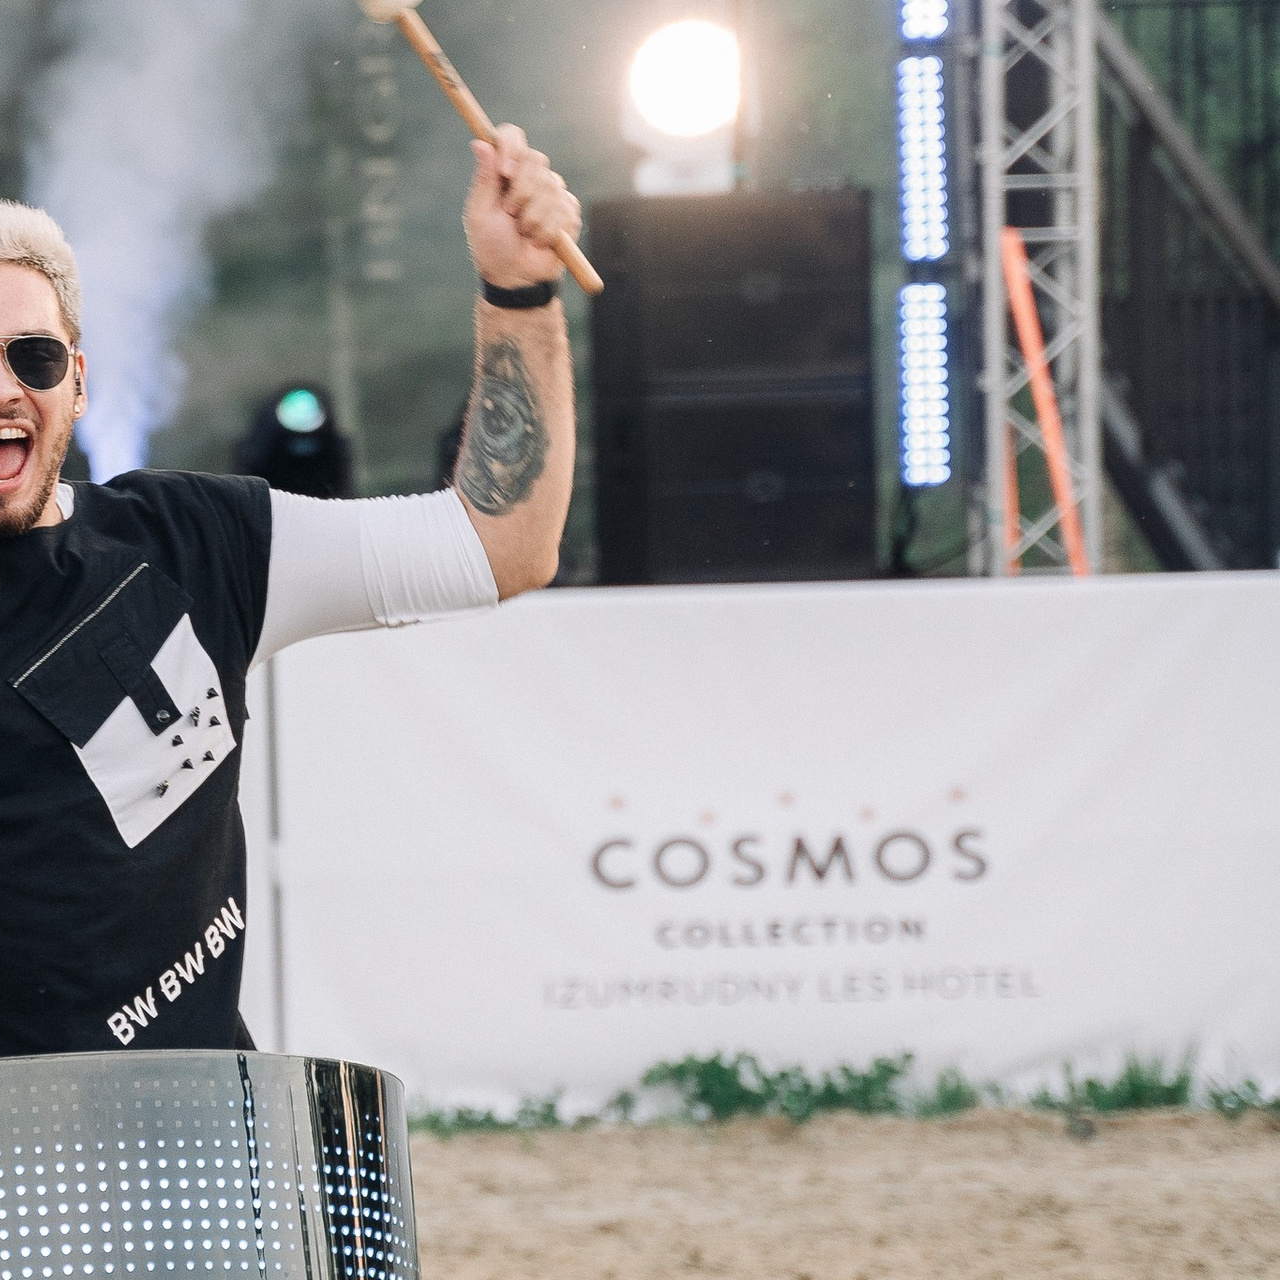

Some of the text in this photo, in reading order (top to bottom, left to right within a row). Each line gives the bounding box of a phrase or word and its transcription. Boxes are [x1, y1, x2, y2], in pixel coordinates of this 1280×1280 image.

[591, 827, 989, 891] COSMOS
[654, 914, 927, 950] COLLECTION
[107, 897, 246, 1046] BW BW BW
[820, 967, 890, 1005] LES
[902, 964, 1042, 1001] HOTEL
